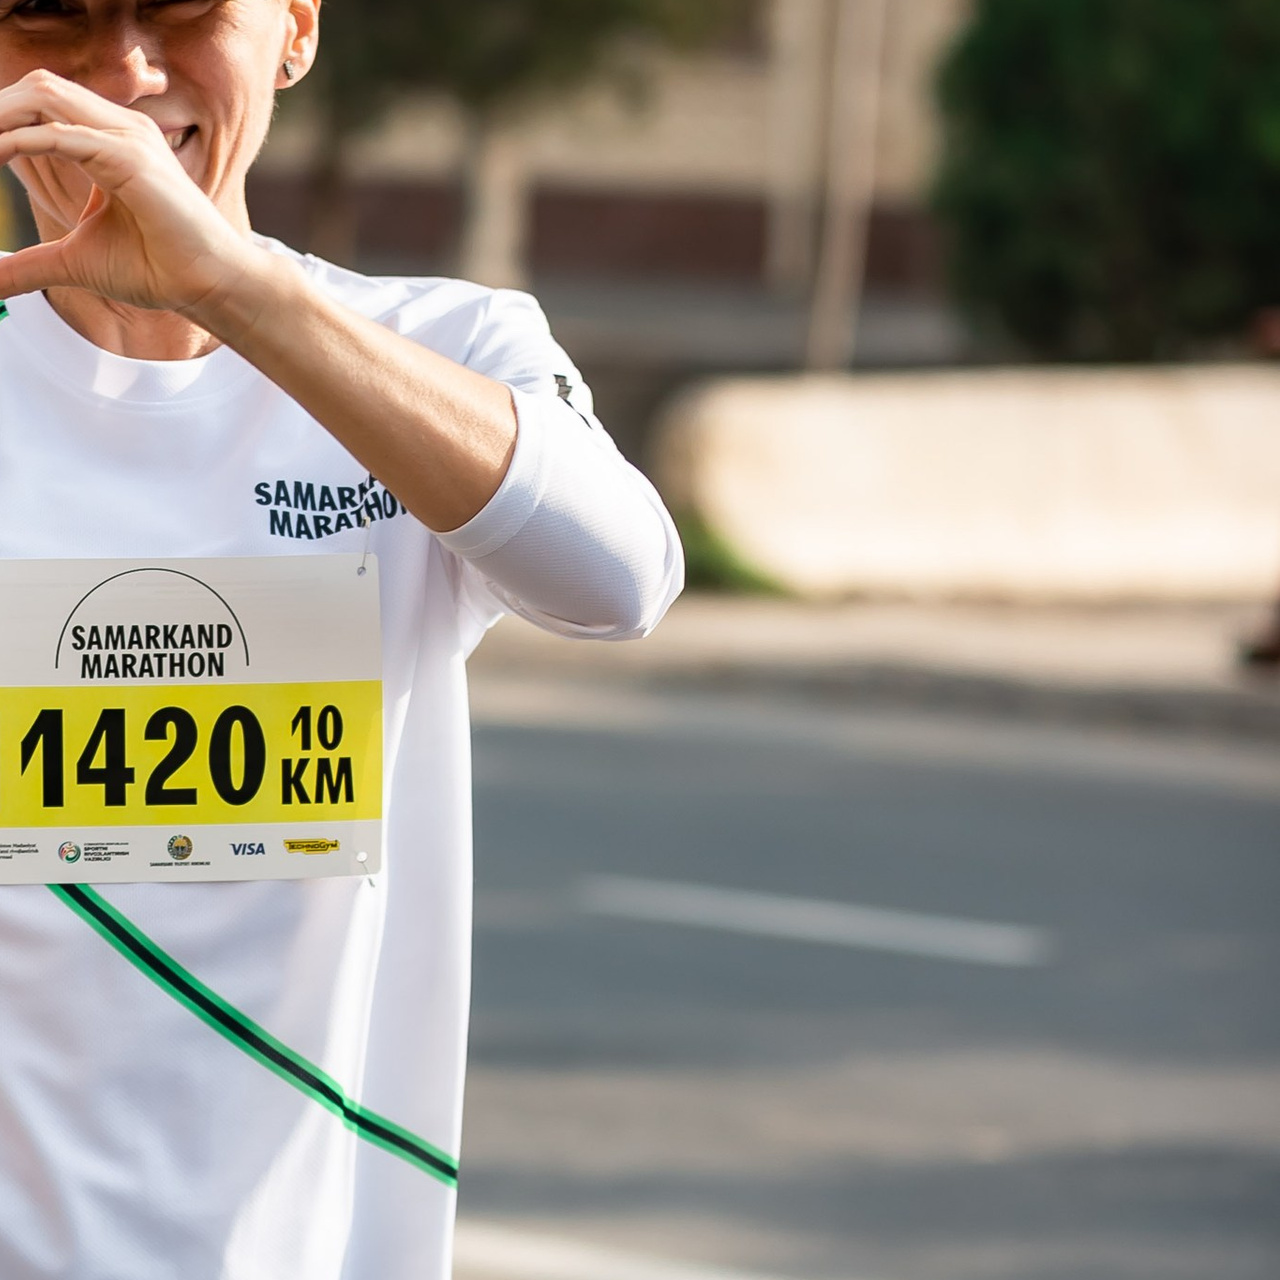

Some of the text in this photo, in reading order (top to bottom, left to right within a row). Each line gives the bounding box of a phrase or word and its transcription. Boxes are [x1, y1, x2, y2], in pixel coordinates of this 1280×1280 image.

[71, 623, 233, 651] SAMARKAND
[80, 652, 225, 679] MARATHON
[291, 704, 344, 751] 10
[20, 704, 266, 808] 1420
[281, 756, 355, 805] KM
[229, 843, 266, 856] VISA
